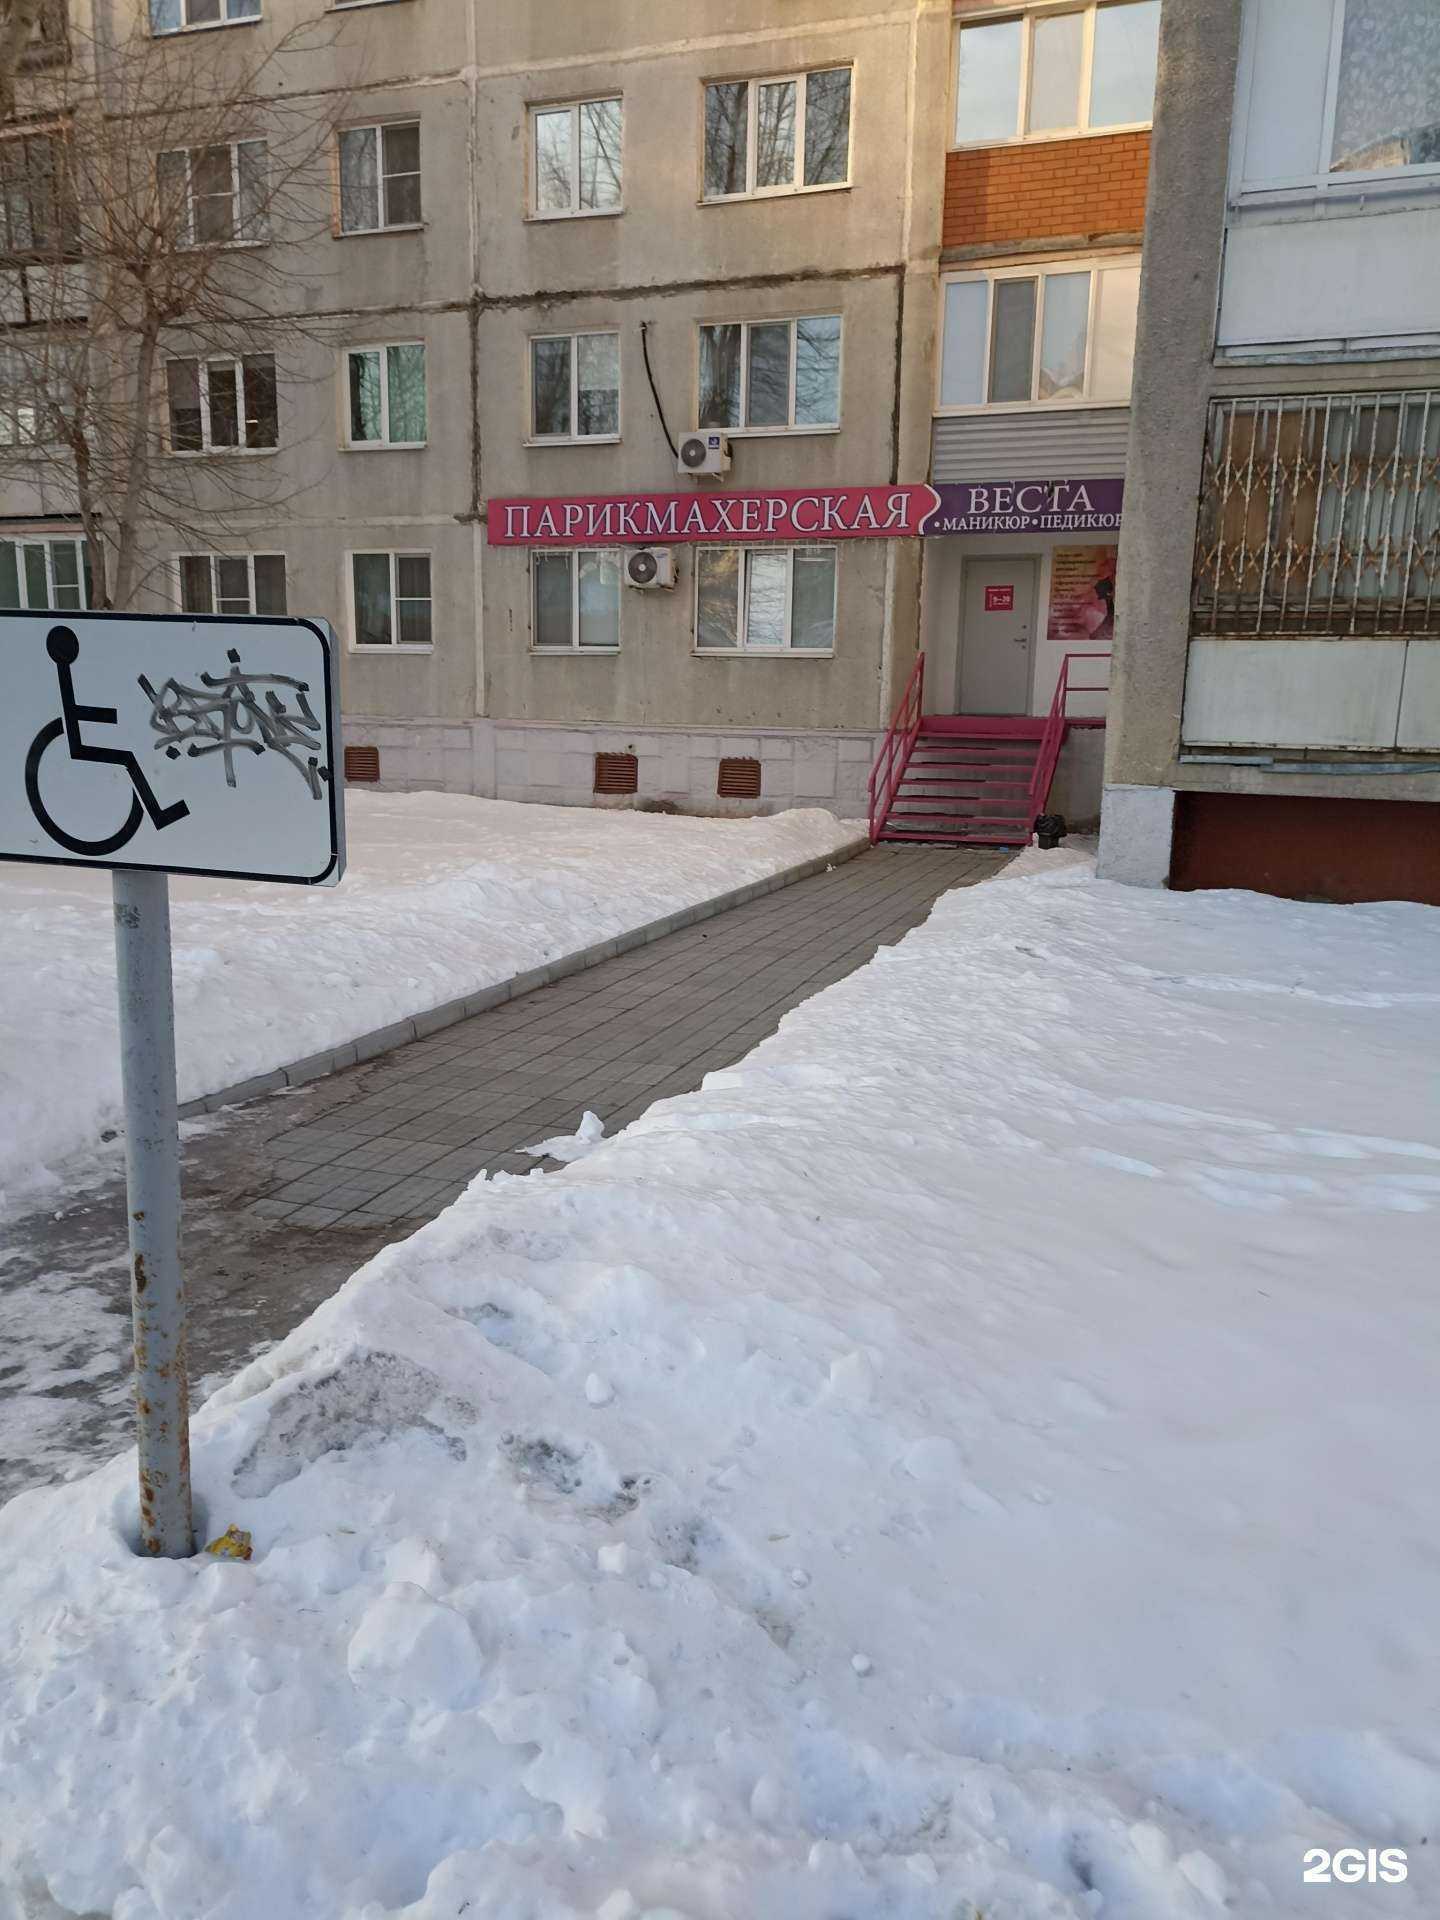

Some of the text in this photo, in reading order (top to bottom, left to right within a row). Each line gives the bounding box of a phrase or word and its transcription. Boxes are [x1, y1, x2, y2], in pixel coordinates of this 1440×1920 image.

[967, 485, 1095, 514] ВЕСТА
[504, 493, 911, 538] ПАРИКМАХЕРСКАЯ
[942, 515, 1030, 531] МАНИКЮР
